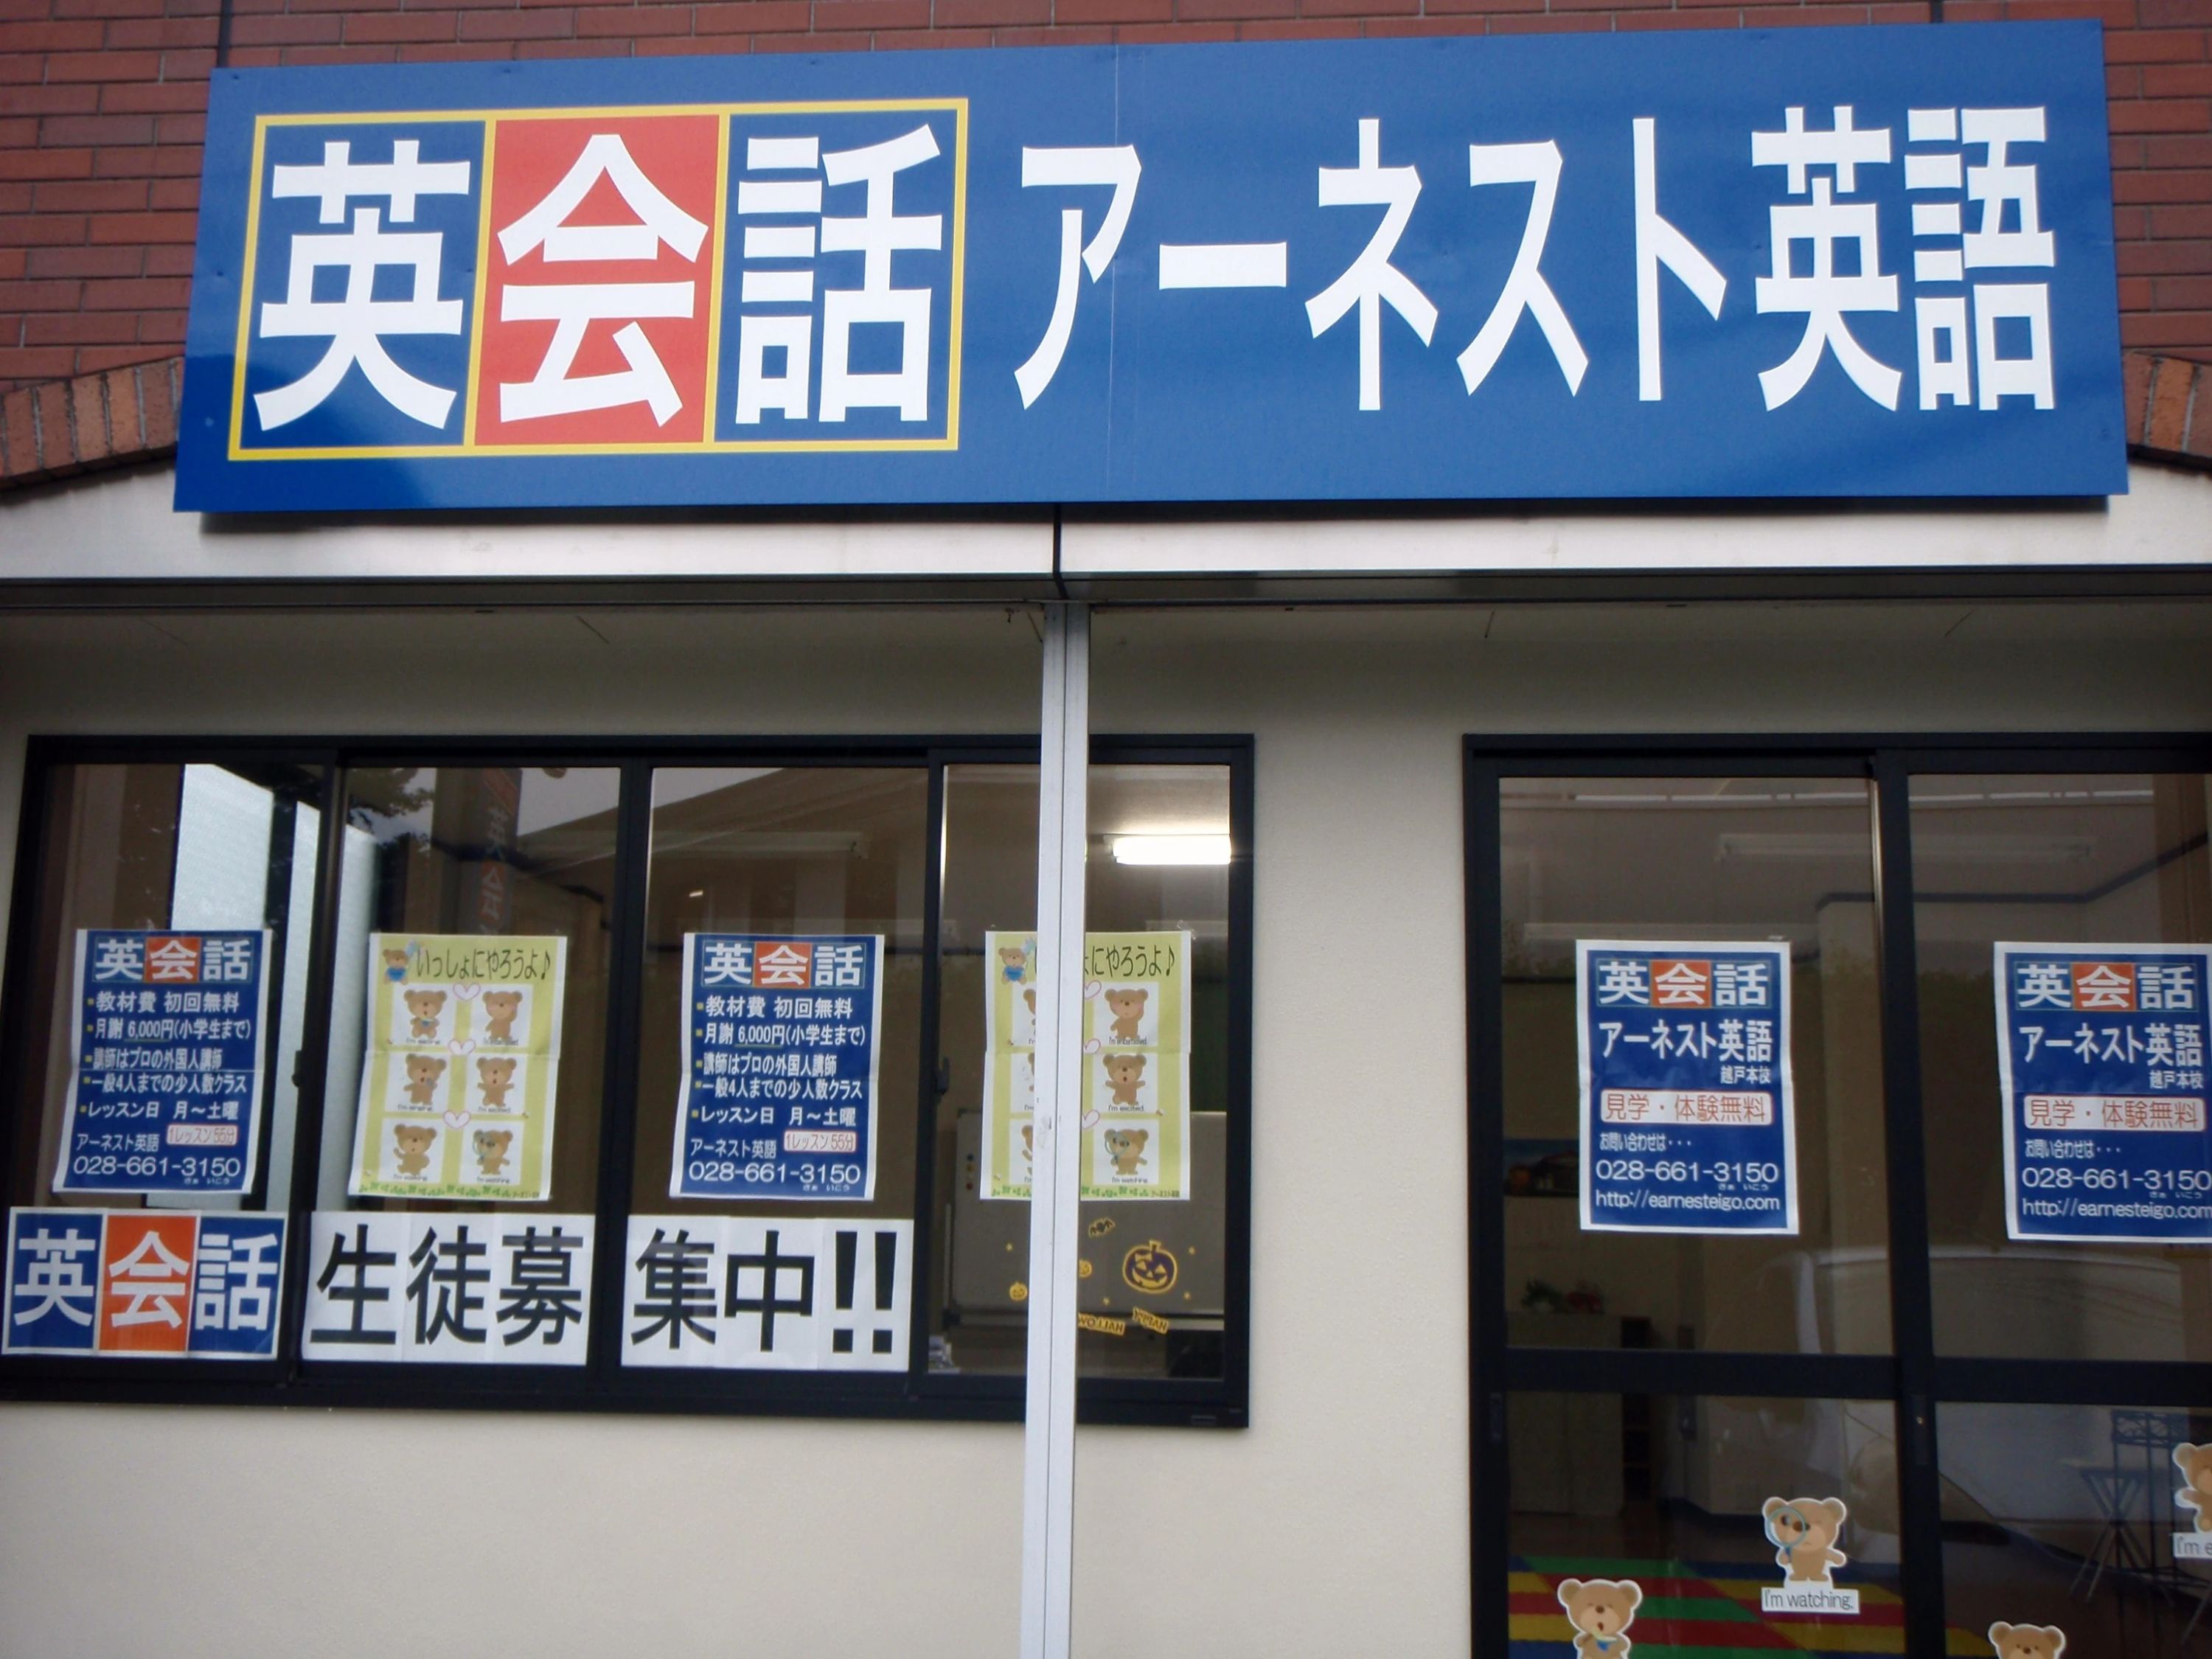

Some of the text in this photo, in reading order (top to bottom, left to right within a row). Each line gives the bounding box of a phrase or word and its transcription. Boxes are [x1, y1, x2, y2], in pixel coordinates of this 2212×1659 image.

[253, 105, 2054, 431] 英会話 アーネスト英語
[95, 939, 251, 981] 英会話
[704, 942, 863, 987] 英会話
[1599, 961, 1768, 1006] 英会話
[2017, 964, 2194, 1009] 英会話
[97, 991, 240, 1013] 教材費 初回無料
[706, 995, 852, 1019] 教材費 初回無料
[703, 1023, 734, 1045] 月謝
[1599, 1019, 1773, 1062] アーネスト英語
[2019, 1023, 2202, 1067] アーネスト英語
[703, 1052, 837, 1077] 講師はプロの外国人講師
[702, 1079, 863, 1100] 一般4人までの少人数クラス
[88, 1102, 159, 1119] レッスン日
[701, 1106, 774, 1124] レッスン日
[1606, 1093, 1765, 1122] 見学・体験無料
[2031, 1099, 2198, 1128] 見学・体験無料
[76, 1133, 160, 1152] アーネスト英語
[691, 1138, 776, 1158] アーネスト英語
[74, 1156, 240, 1177] 028-661-3150
[689, 1161, 860, 1183] 028-661-3150
[1596, 1160, 1778, 1183] 028-661-3150
[2022, 1167, 2212, 1191] 028-661-3150
[1596, 1189, 1780, 1211] http://earnesteigo.com
[13, 1228, 279, 1332] 英会話
[1764, 1589, 1783, 1607] I'm
